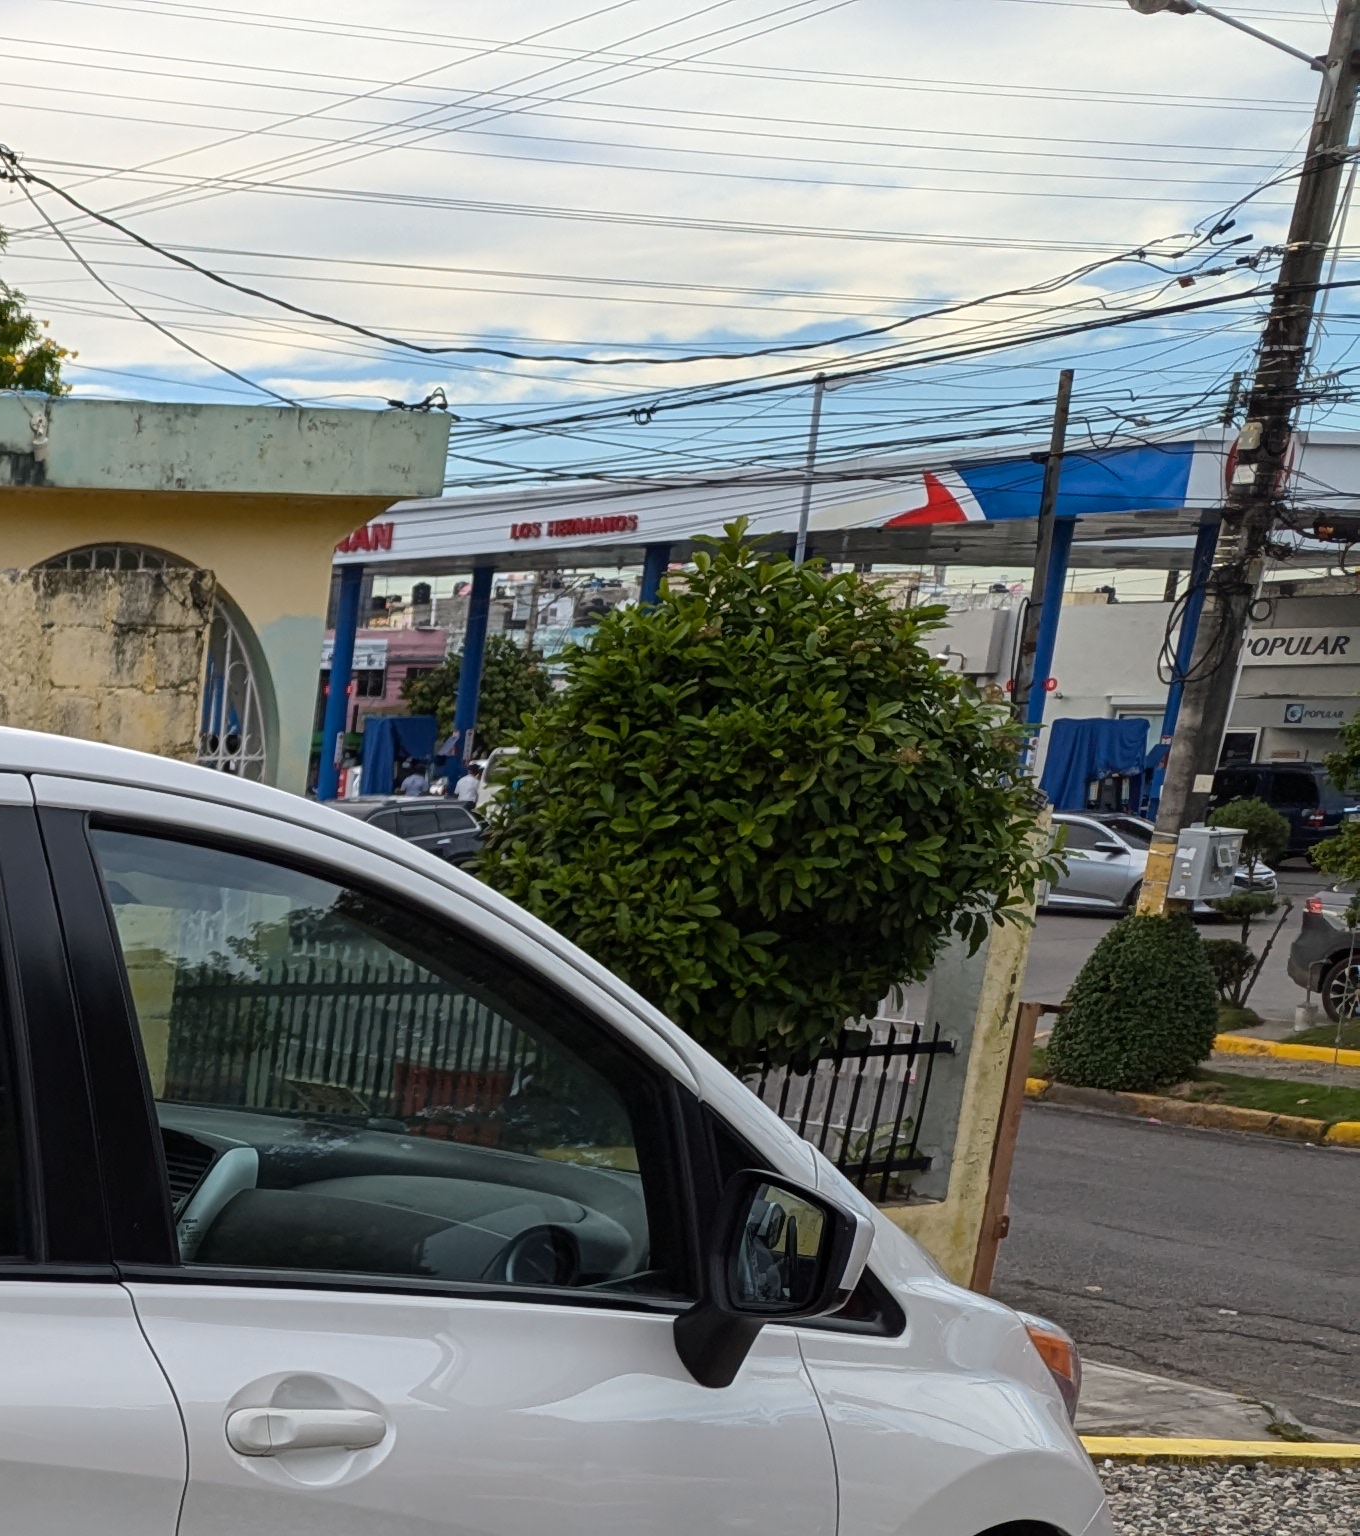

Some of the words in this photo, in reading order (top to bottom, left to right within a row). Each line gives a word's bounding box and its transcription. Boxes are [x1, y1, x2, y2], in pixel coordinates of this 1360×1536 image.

[510, 522, 542, 540] LOS
[546, 515, 638, 537] HERMANOS
[1304, 710, 1345, 719] POPULAR
